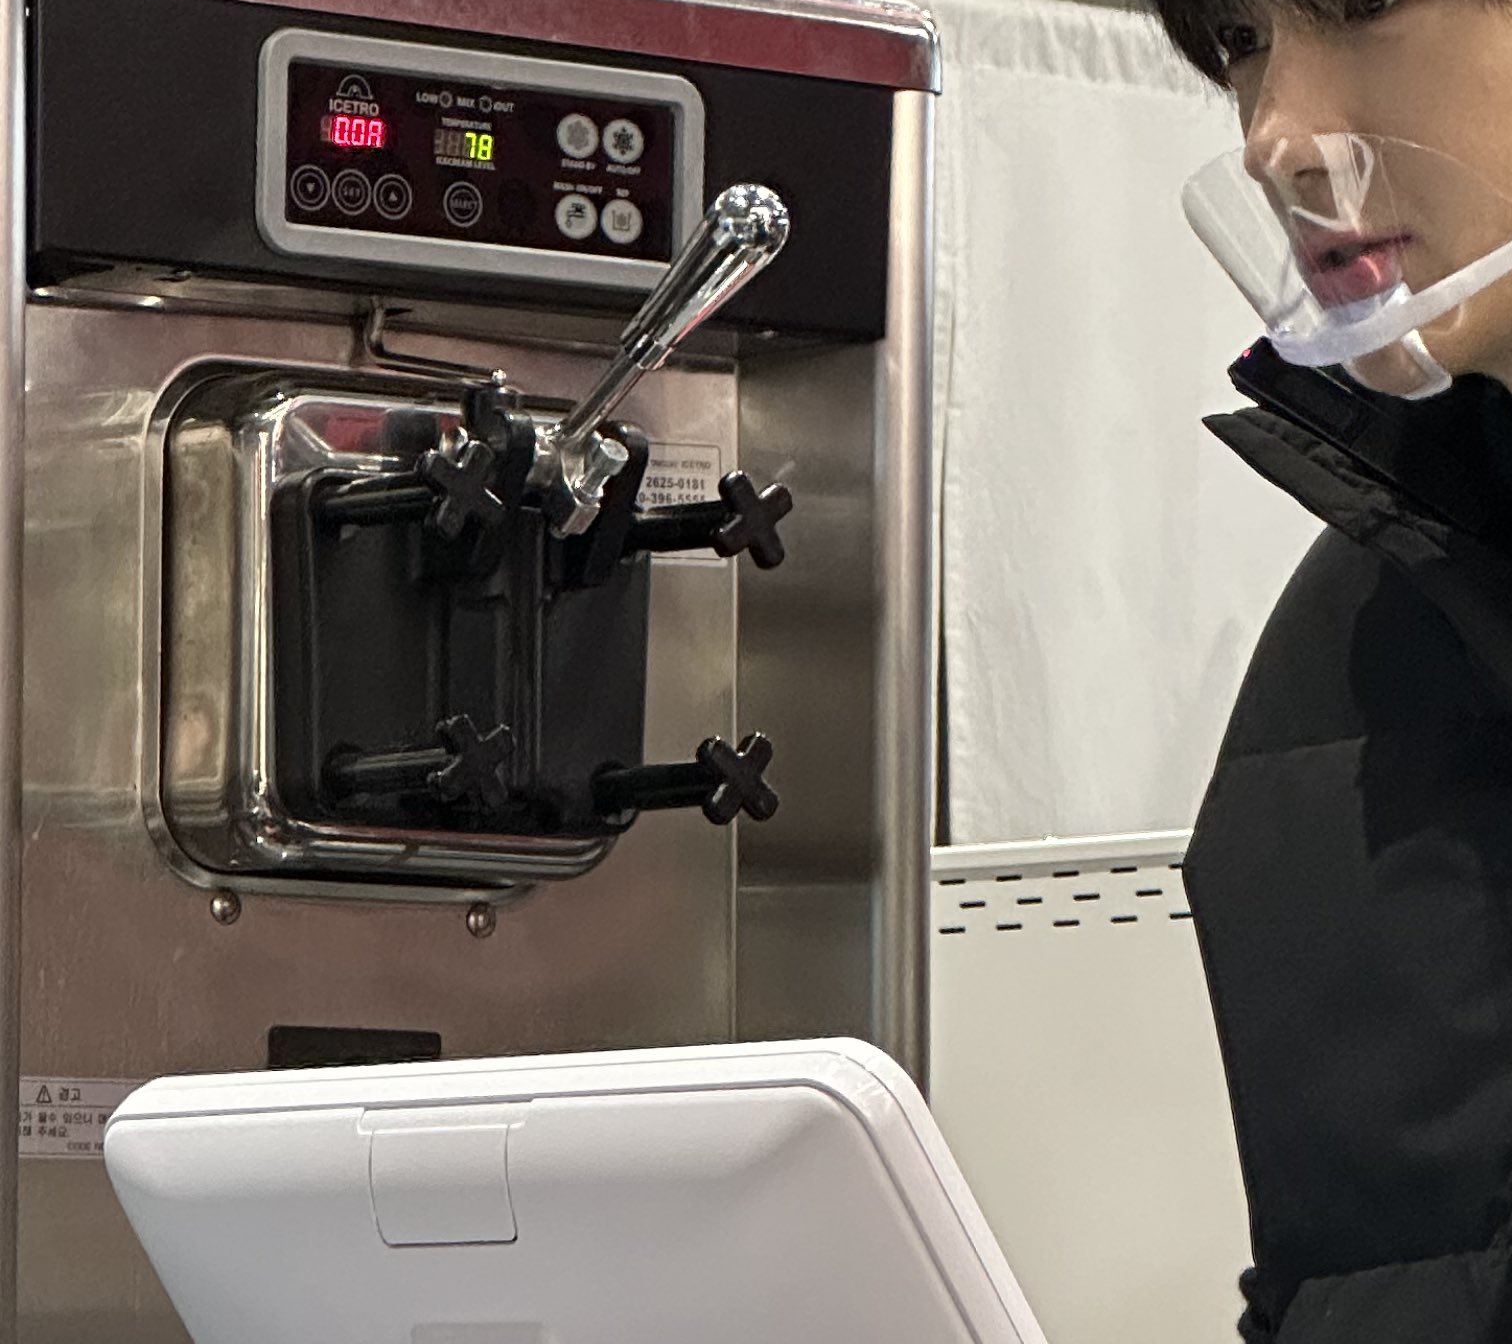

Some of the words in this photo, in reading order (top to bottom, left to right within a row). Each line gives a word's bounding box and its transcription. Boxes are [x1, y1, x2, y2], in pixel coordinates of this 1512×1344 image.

[329, 98, 380, 116] ICETRO
[416, 91, 438, 105] LOW
[493, 101, 515, 113] OUT
[465, 131, 494, 161] 78
